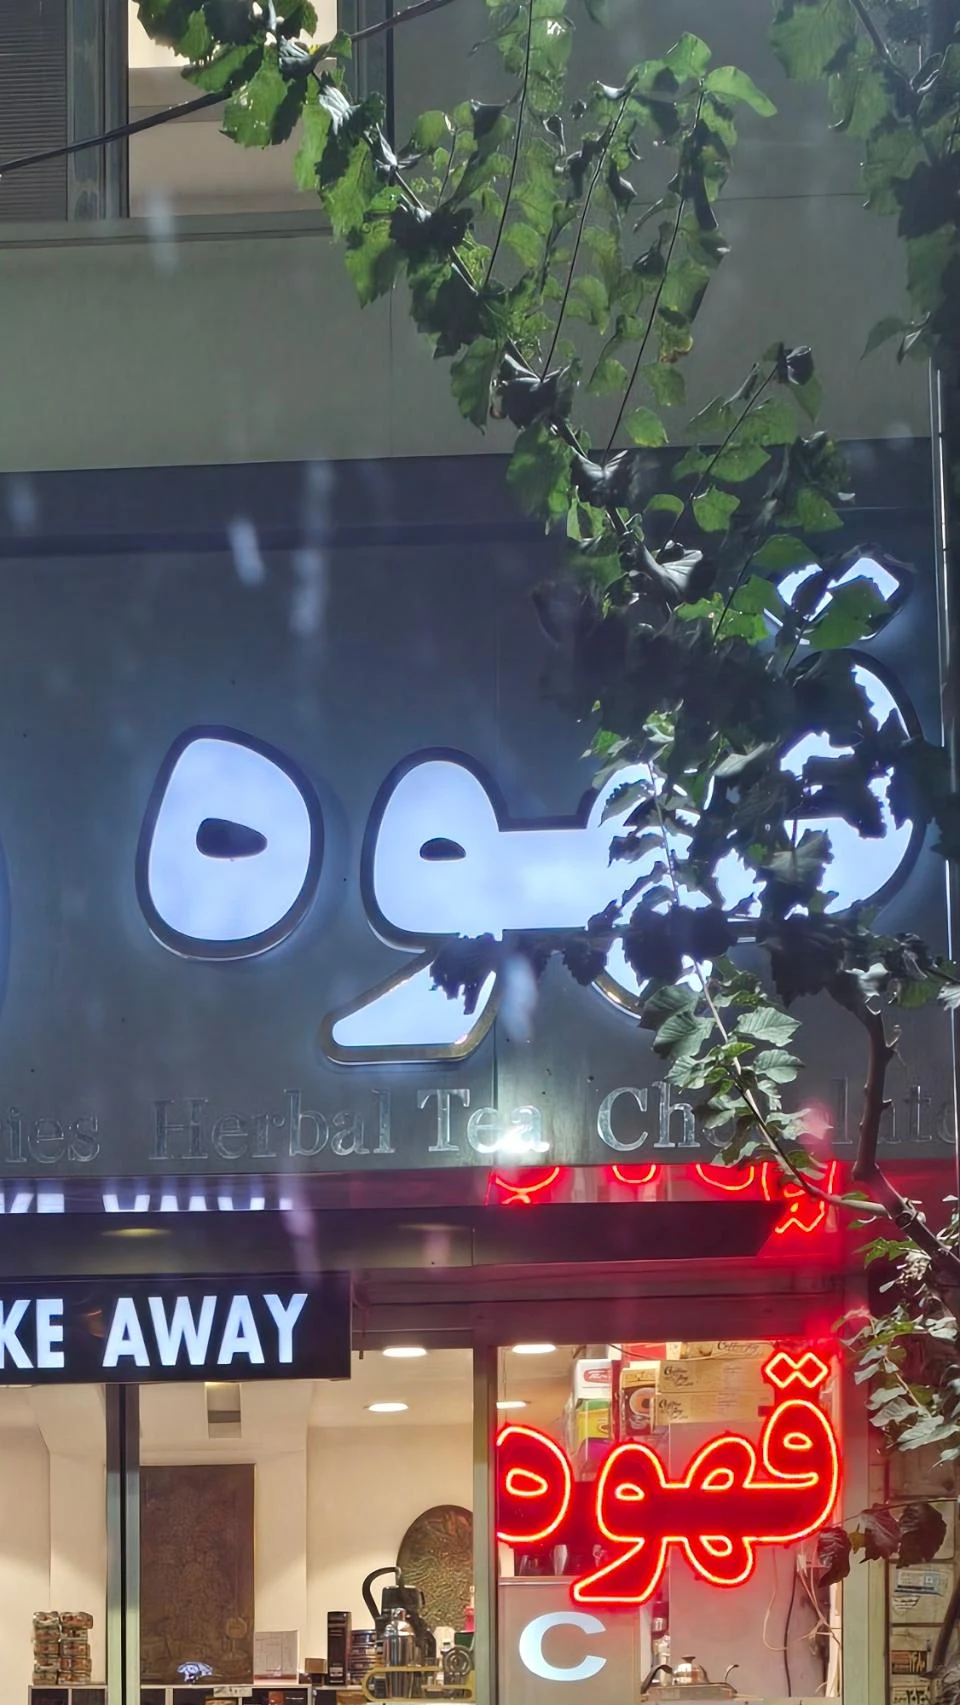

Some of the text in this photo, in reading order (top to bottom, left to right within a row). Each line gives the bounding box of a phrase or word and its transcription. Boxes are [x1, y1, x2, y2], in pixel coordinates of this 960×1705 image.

[147, 1089, 396, 1160] Herbal
[417, 1088, 550, 1154] Tea
[102, 1293, 308, 1368] AWAY
[497, 1350, 839, 1603] قهوه
